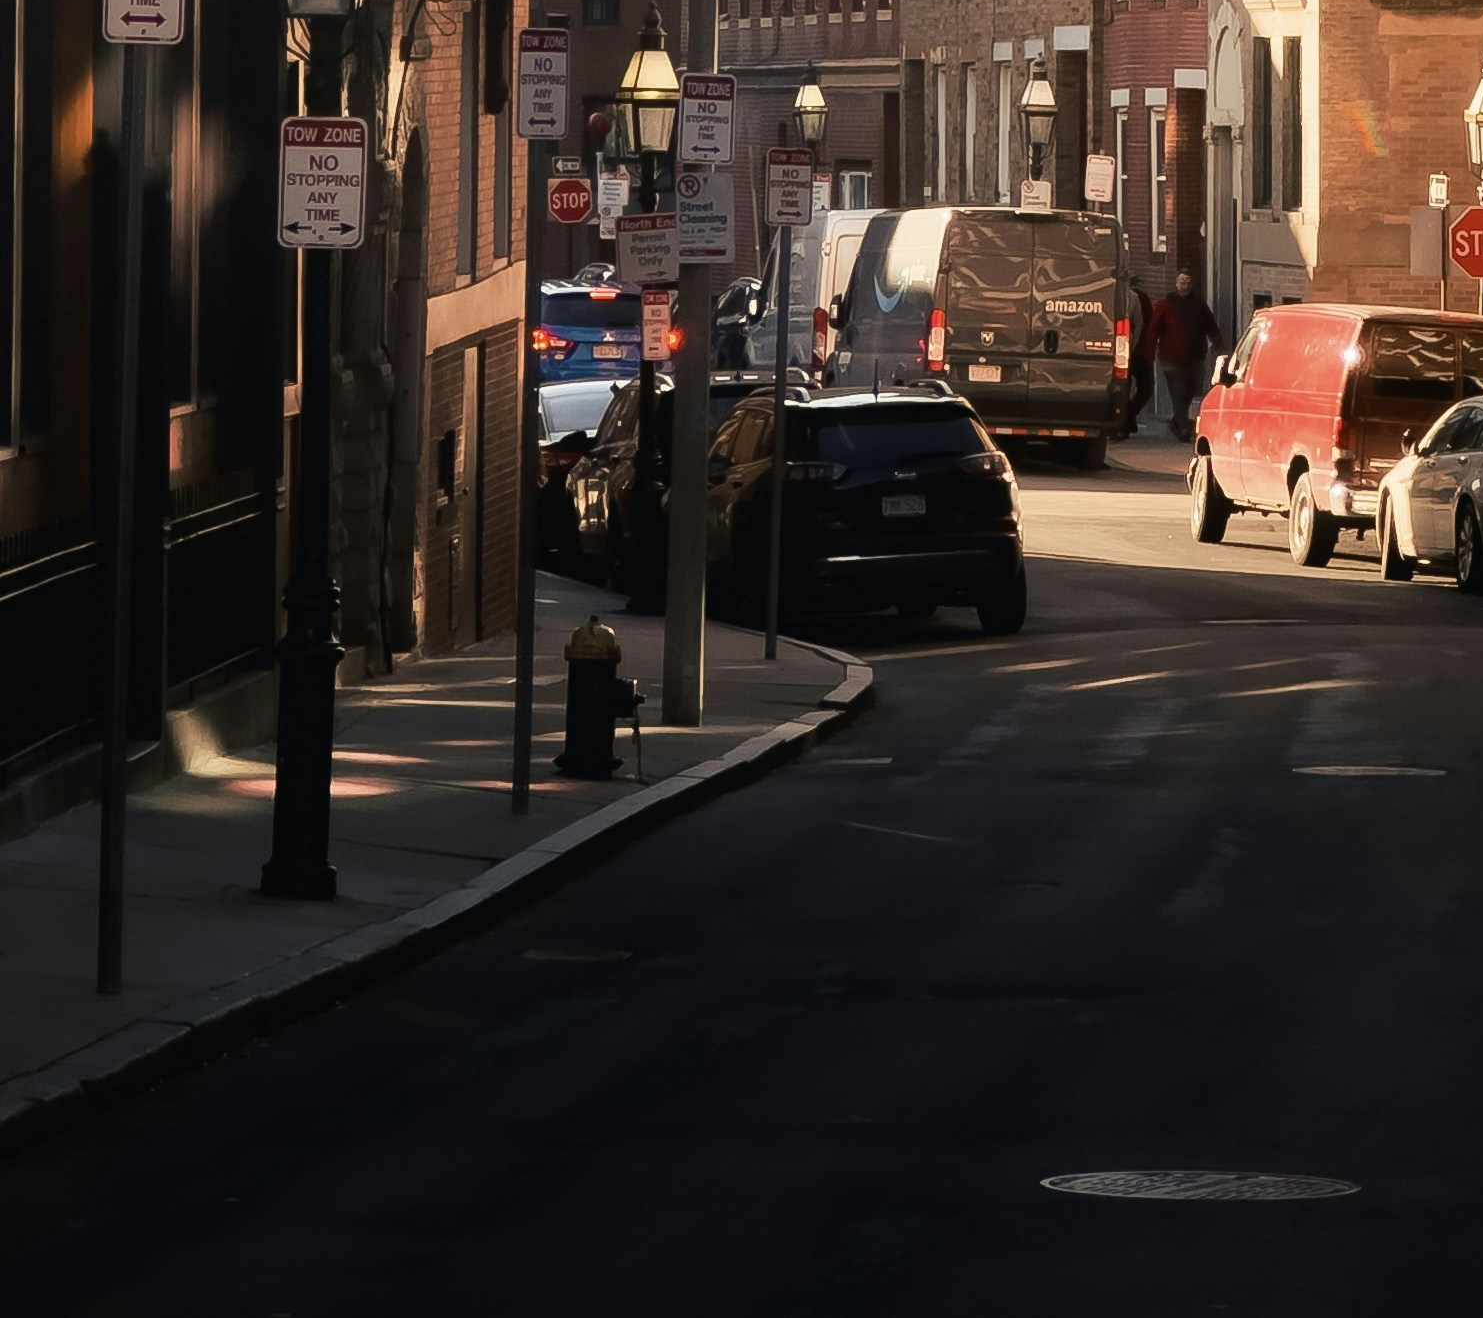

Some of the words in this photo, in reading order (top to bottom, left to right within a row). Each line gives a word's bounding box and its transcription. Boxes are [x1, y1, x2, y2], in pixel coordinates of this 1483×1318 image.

[533, 57, 553, 72] NO
[533, 88, 553, 98] ANY
[686, 81, 706, 96] TOW
[707, 82, 731, 97] ZONE
[697, 102, 717, 114] NO
[286, 126, 318, 142] TOW
[323, 128, 362, 143] ZONE
[309, 154, 338, 171] NO
[286, 173, 360, 187] STOPPING
[782, 169, 799, 179] NO
[307, 191, 339, 204] ANY
[552, 192, 588, 210] STOP
[680, 201, 714, 212] Street
[304, 208, 341, 221] TIME
[679, 214, 727, 226] Cleaning
[621, 219, 652, 230] North
[632, 232, 667, 242] Permit
[629, 244, 671, 255] Parking
[638, 256, 663, 267] Only
[1045, 300, 1103, 313] amazon
